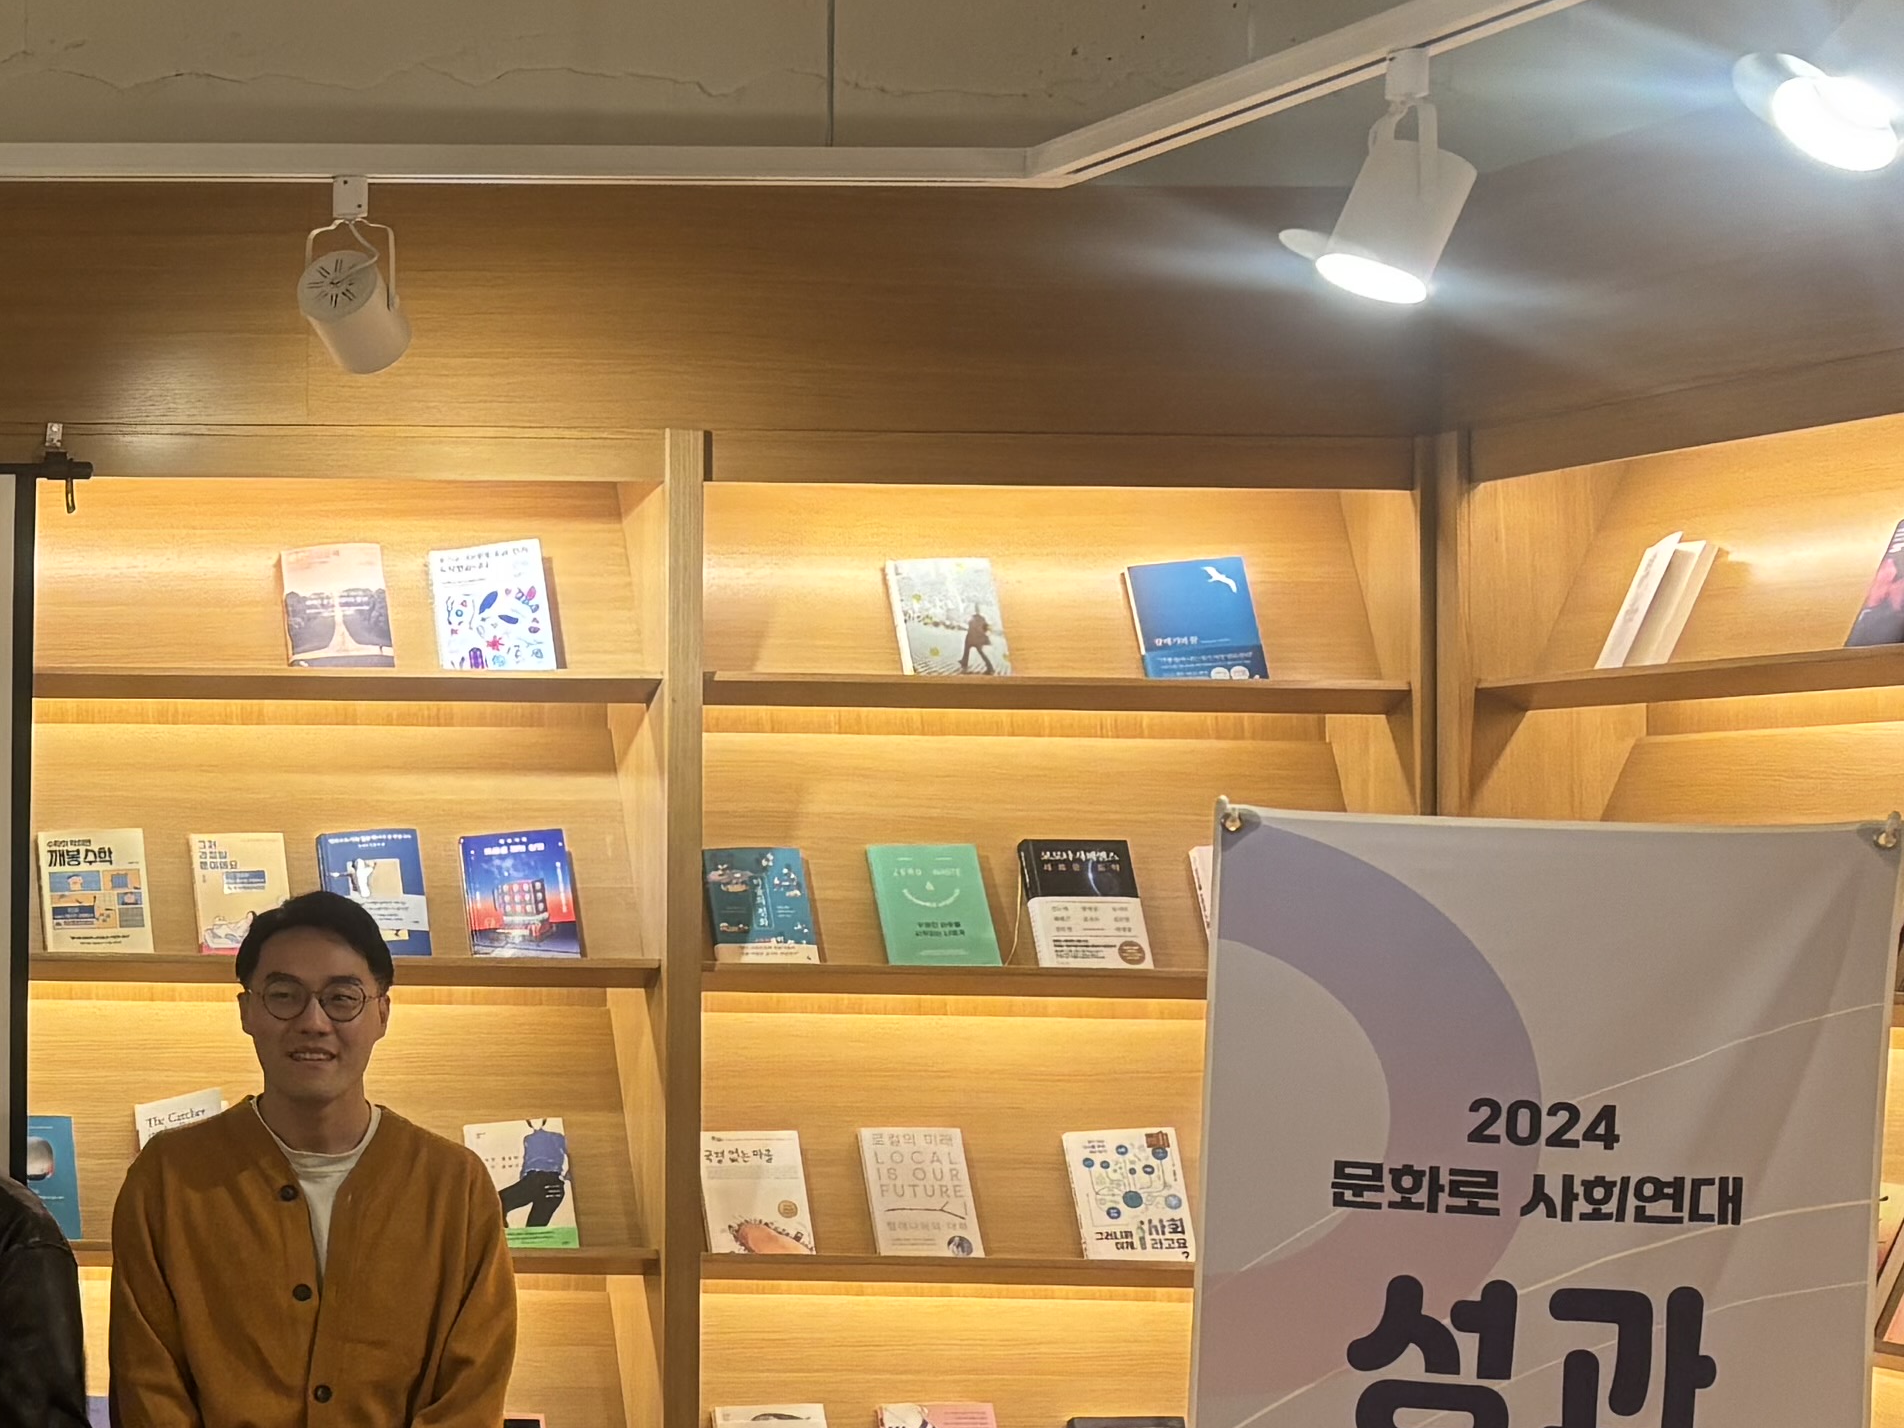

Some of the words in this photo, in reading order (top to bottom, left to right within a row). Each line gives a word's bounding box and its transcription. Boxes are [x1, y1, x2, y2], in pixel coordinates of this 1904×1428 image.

[47, 848, 81, 867] 깨봉
[83, 847, 113, 865] 수학
[1467, 1097, 1621, 1151] 2024
[874, 1151, 960, 1165] LOCAL
[877, 1167, 898, 1181] IS
[912, 1167, 962, 1182] OUR
[880, 1184, 966, 1198] FUTURE
[1331, 1160, 1501, 1218] 문화로
[1520, 1173, 1744, 1226] 사회연대
[1147, 1217, 1186, 1236] 사회
